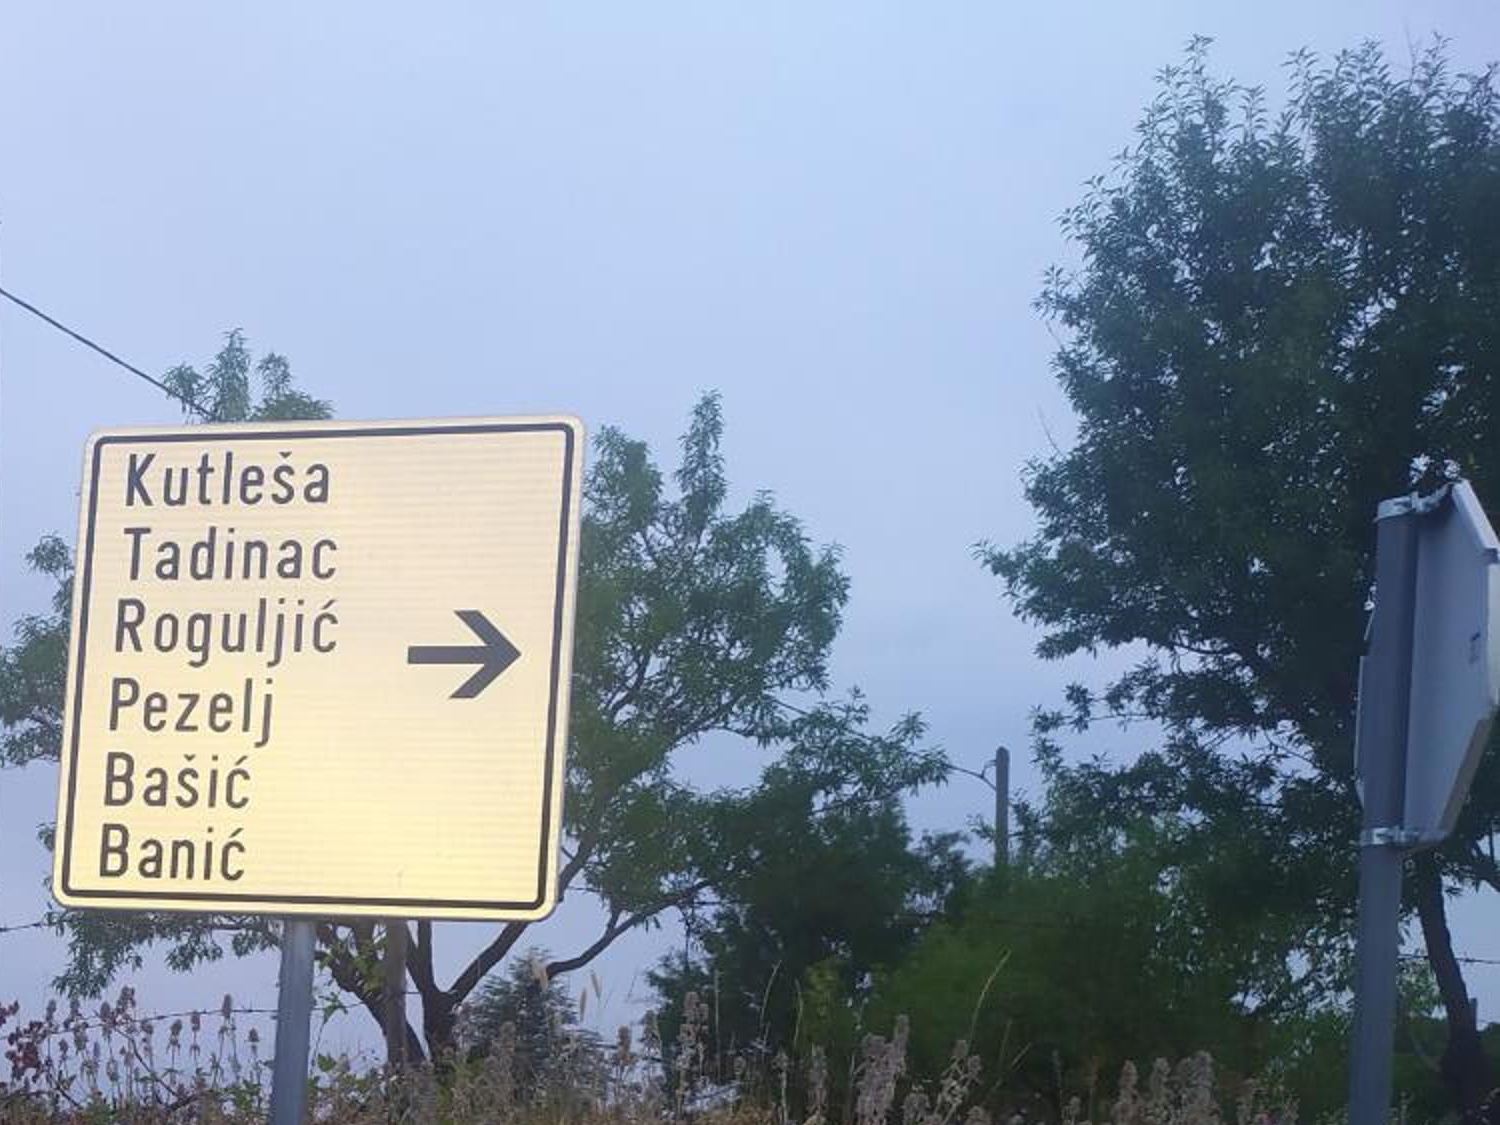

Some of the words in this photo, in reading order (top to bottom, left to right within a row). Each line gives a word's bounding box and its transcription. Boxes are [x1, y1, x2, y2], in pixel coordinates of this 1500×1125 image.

[124, 451, 331, 507] Kutleša
[123, 526, 338, 581] Tadinac
[114, 598, 339, 668] Roguljić
[108, 677, 275, 748] Pezelj
[103, 751, 251, 808] Bašić
[99, 823, 245, 881] Banić
